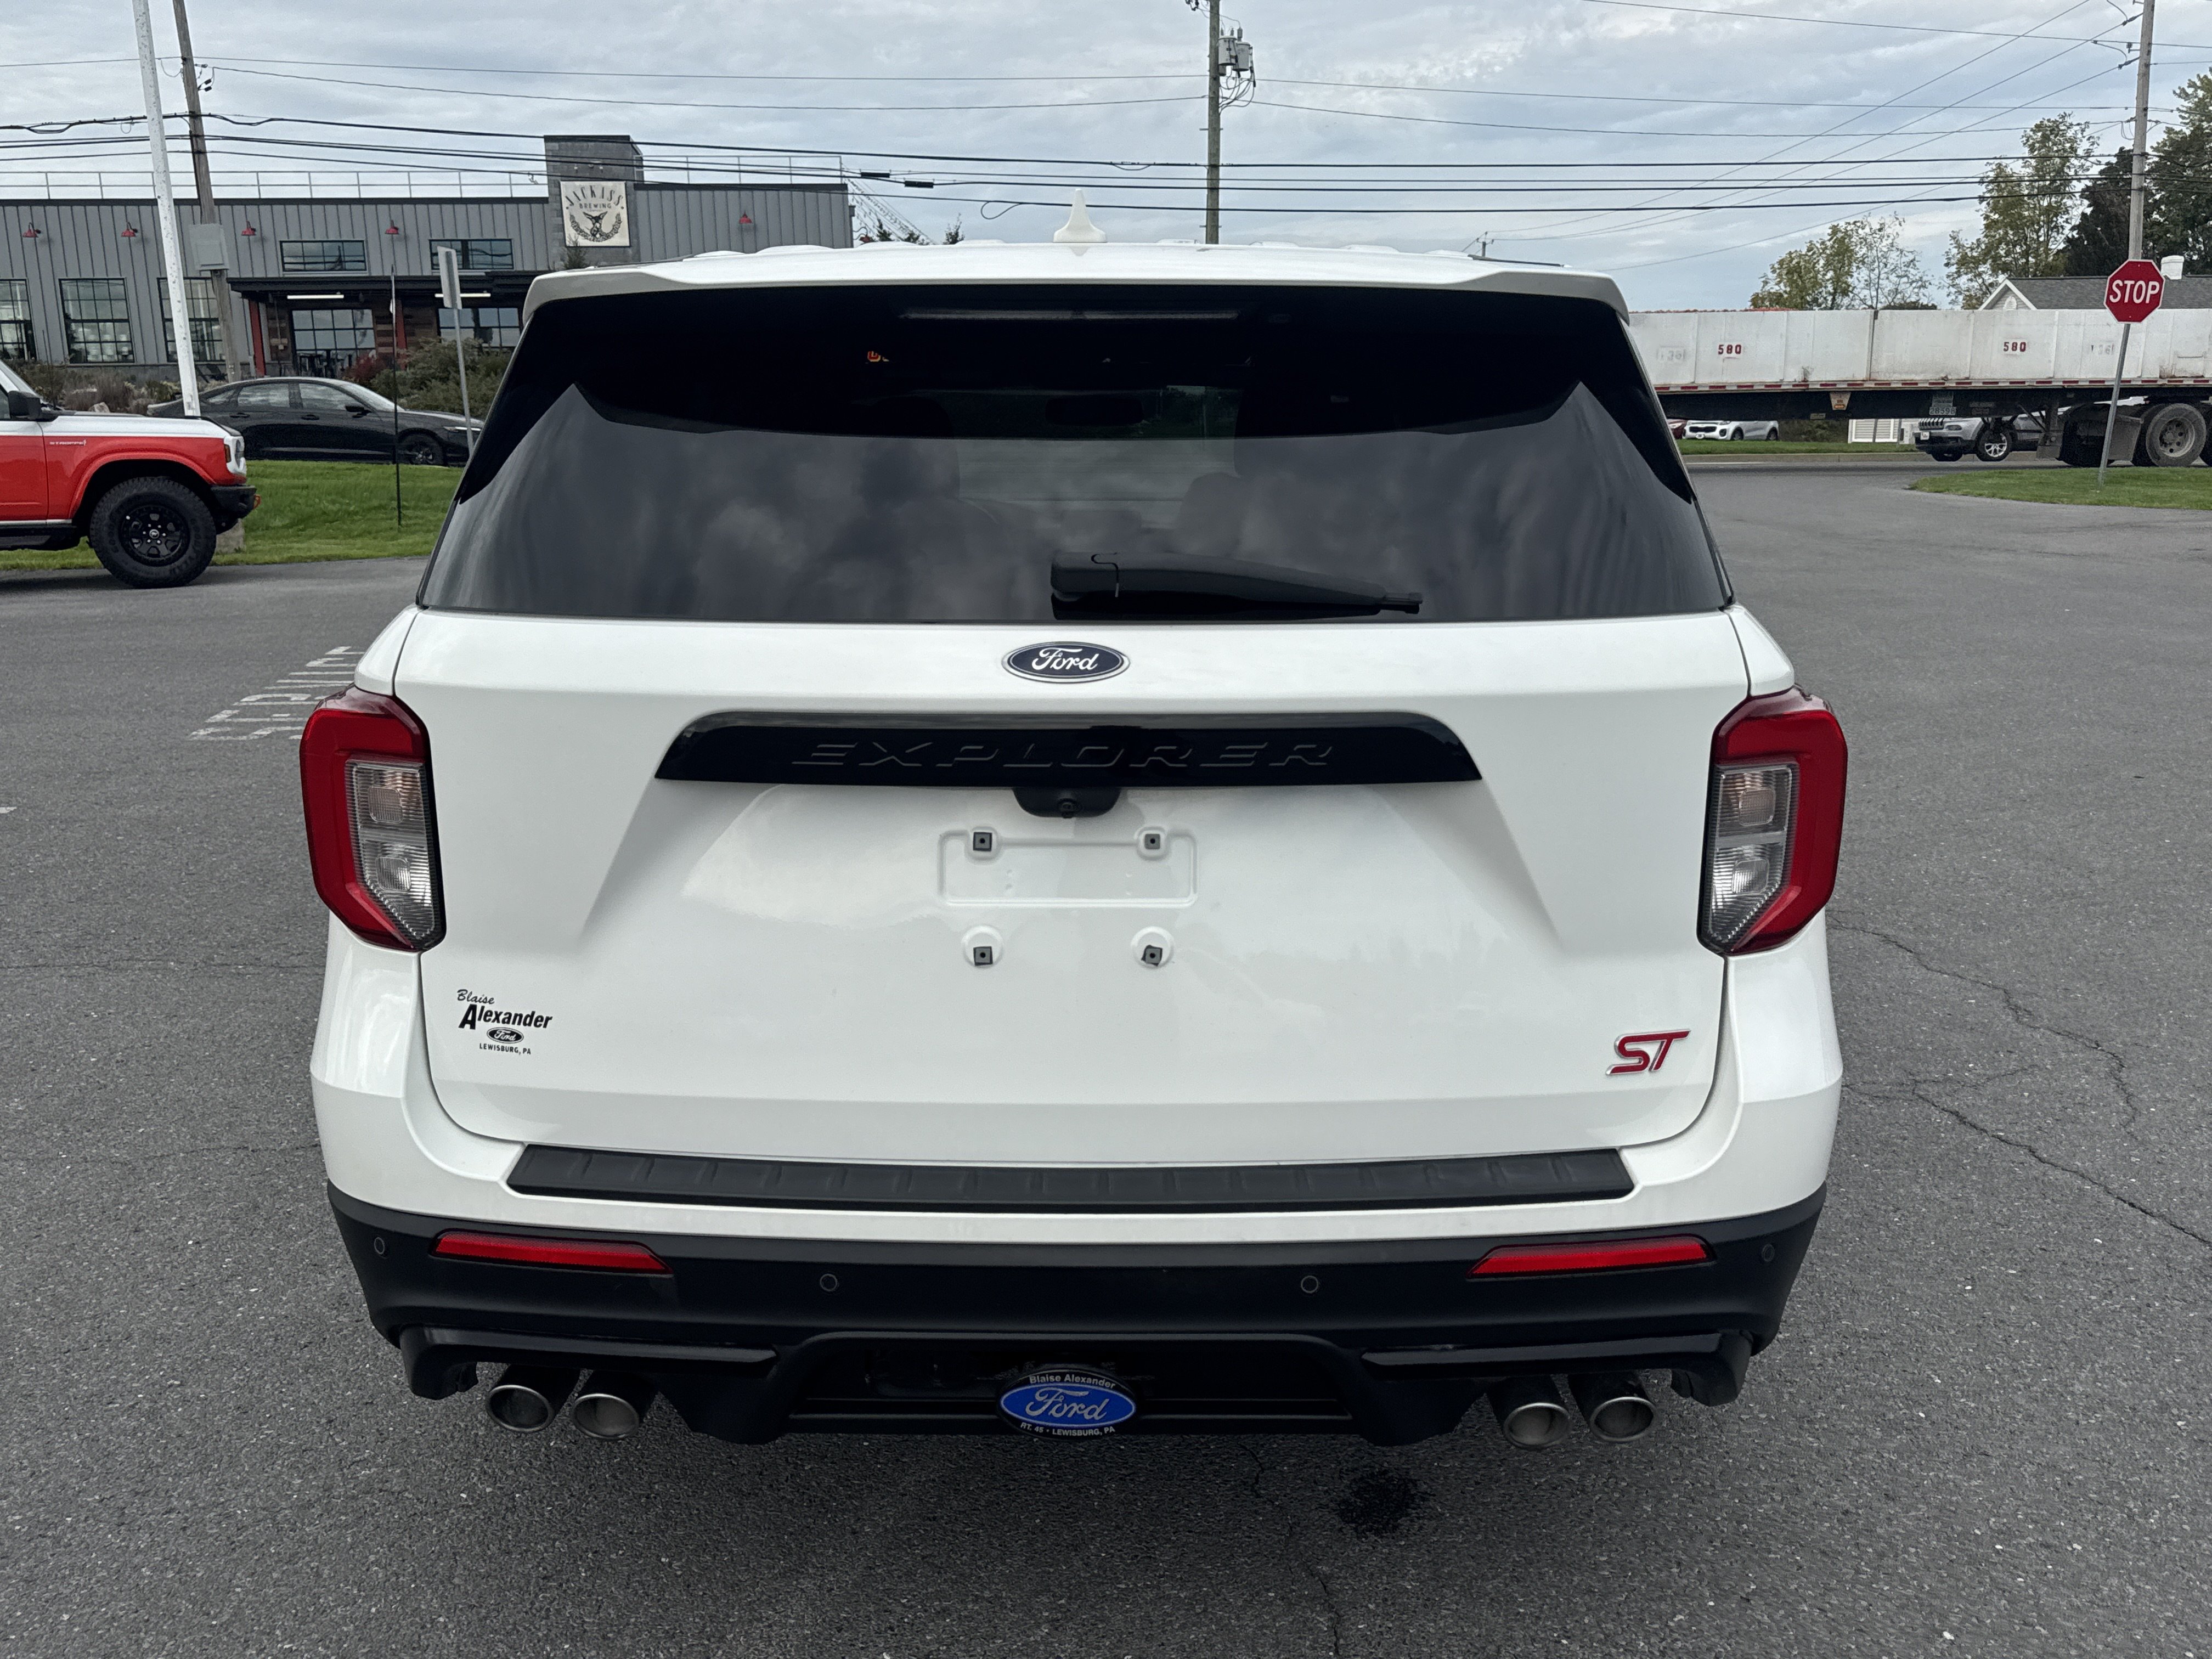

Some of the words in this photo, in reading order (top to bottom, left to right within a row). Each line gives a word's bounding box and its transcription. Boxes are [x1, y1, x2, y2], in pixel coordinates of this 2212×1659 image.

[2109, 279, 2160, 303] STOP
[1718, 344, 1741, 355] 580
[2003, 341, 2027, 352] 580
[1031, 647, 1099, 670] Ford
[792, 742, 1332, 767] EXPLORER
[456, 989, 495, 1005] Blaise
[458, 1003, 553, 1030] Alexander
[494, 1029, 516, 1041] Ford
[479, 1043, 521, 1055] LEWISBURG,
[1605, 1029, 1691, 1075] ST
[1029, 1374, 1062, 1384] Blaise
[1064, 1374, 1116, 1389] Alexander
[1025, 1387, 1110, 1420] Ford
[1020, 1422, 1032, 1431] RT.
[1052, 1427, 1103, 1436] LEWISBURG,
